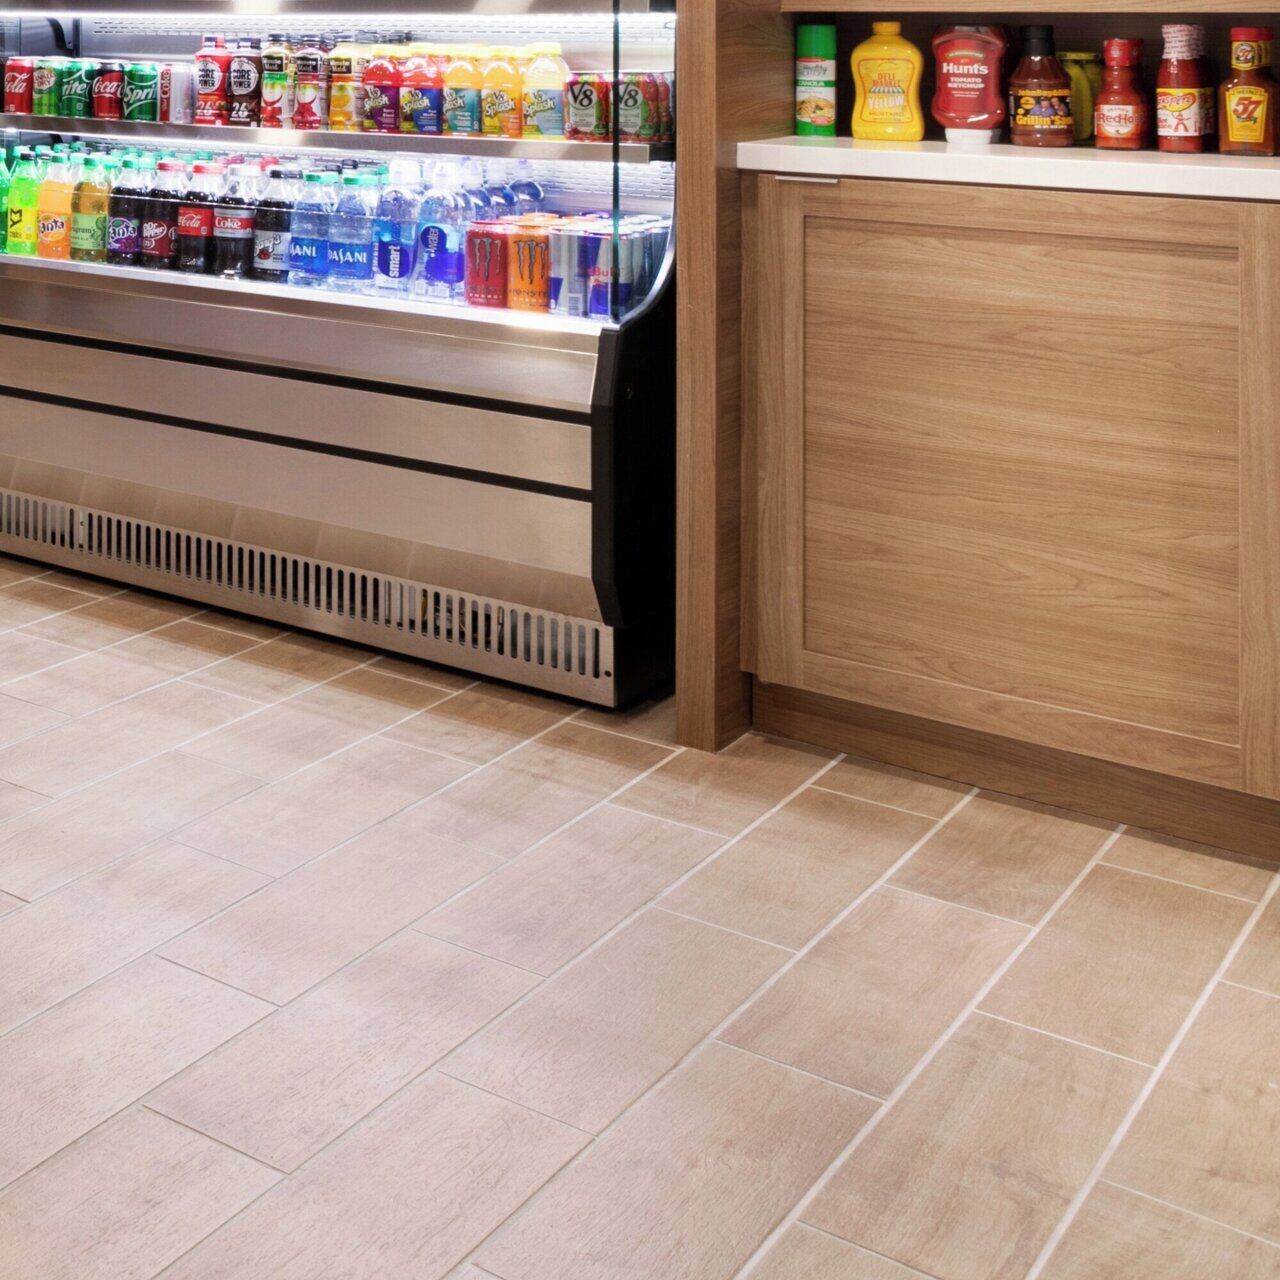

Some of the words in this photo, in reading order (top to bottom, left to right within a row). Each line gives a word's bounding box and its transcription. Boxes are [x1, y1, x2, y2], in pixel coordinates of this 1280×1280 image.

[233, 69, 251, 79] CORE
[943, 63, 989, 75] Hunt's
[62, 79, 87, 95] rite
[233, 80, 252, 89] POWER
[125, 86, 159, 104] Spri
[569, 84, 594, 107] V8
[869, 95, 904, 110] YELLOW
[485, 100, 515, 116] Splash
[1233, 97, 1263, 116] 57
[40, 219, 65, 234] anta
[215, 218, 241, 229] Coke
[390, 245, 400, 278] smart
